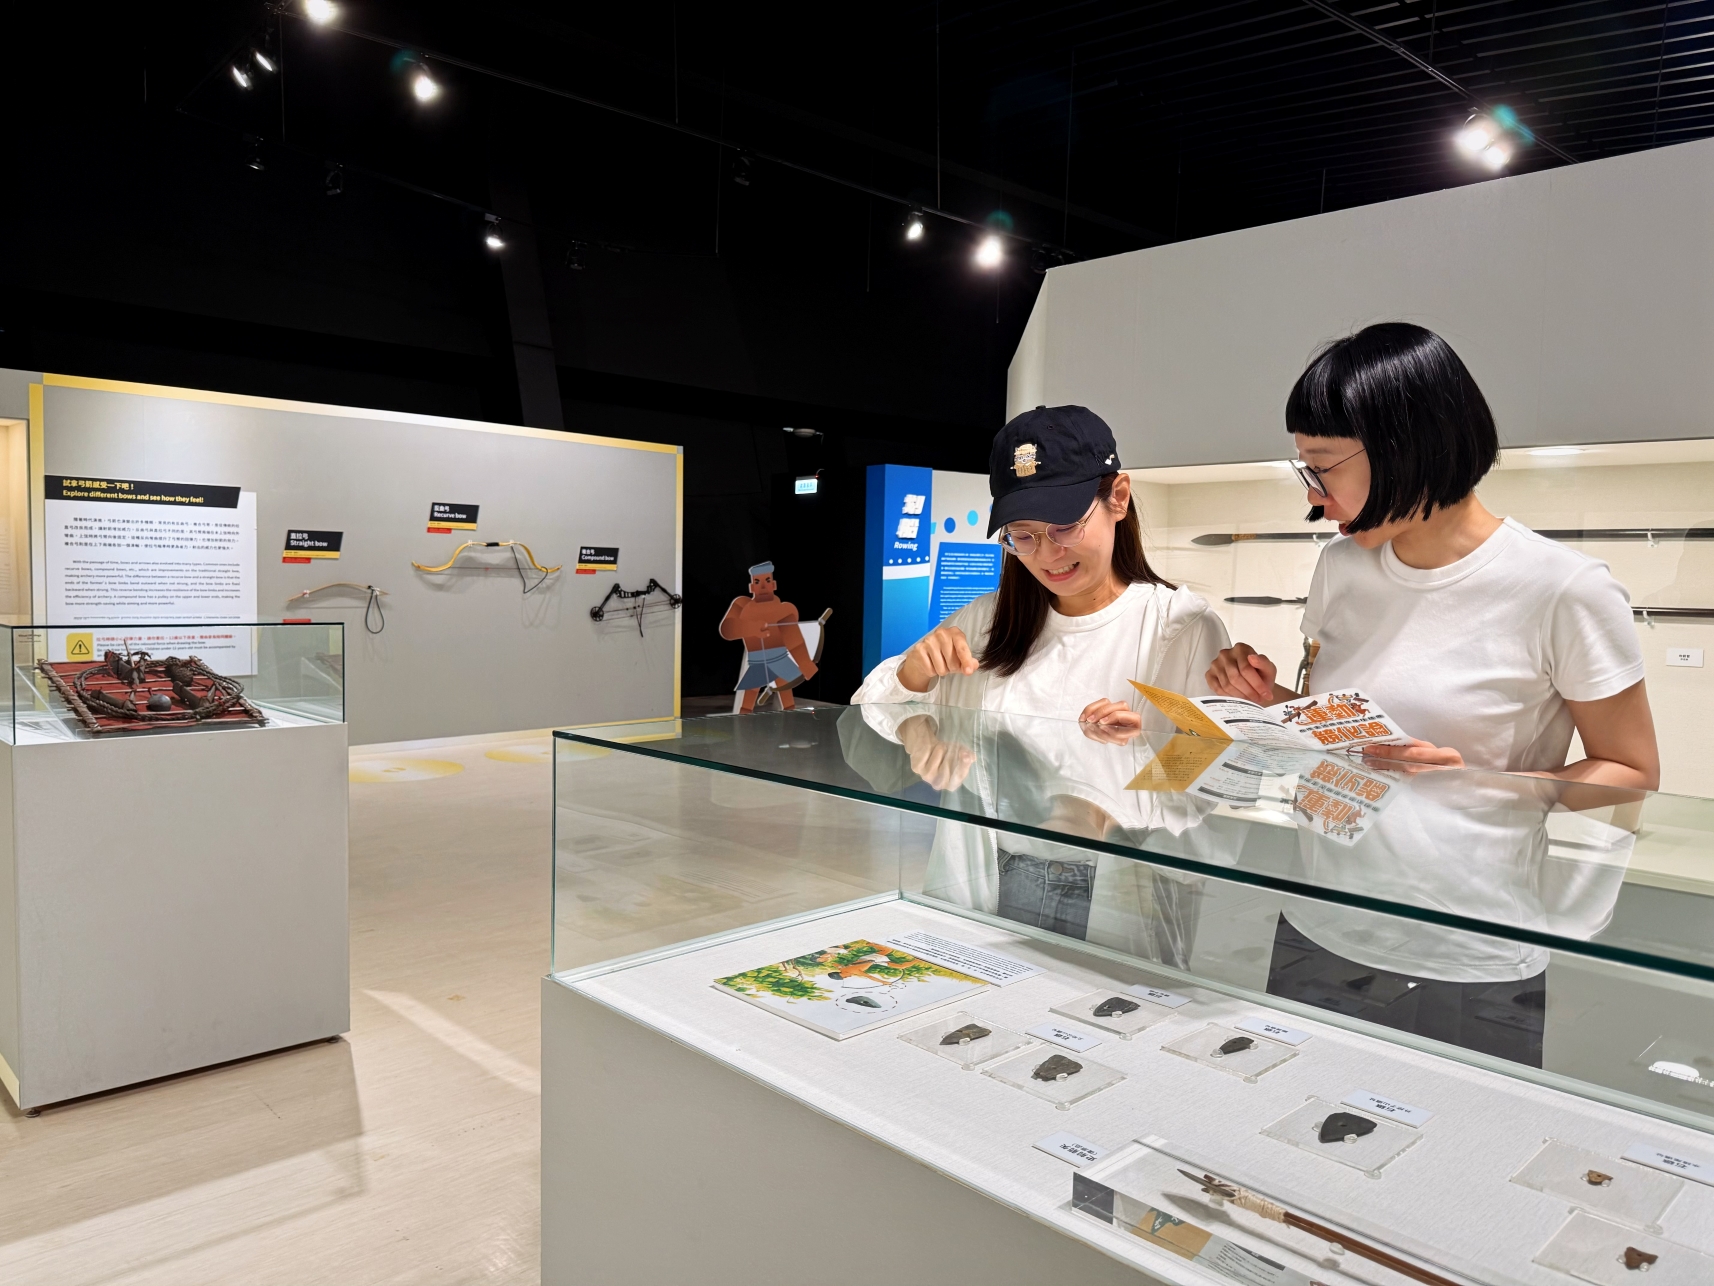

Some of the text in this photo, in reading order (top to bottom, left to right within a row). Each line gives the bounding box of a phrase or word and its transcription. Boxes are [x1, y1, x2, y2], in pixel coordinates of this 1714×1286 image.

[63, 490, 88, 498] Explore
[89, 491, 118, 499] different
[290, 532, 309, 540] 直拉弓
[290, 540, 314, 548] Straight
[894, 542, 918, 551] Rowing
[1295, 696, 1359, 726] 運動
[1311, 721, 1392, 746] 競化論
